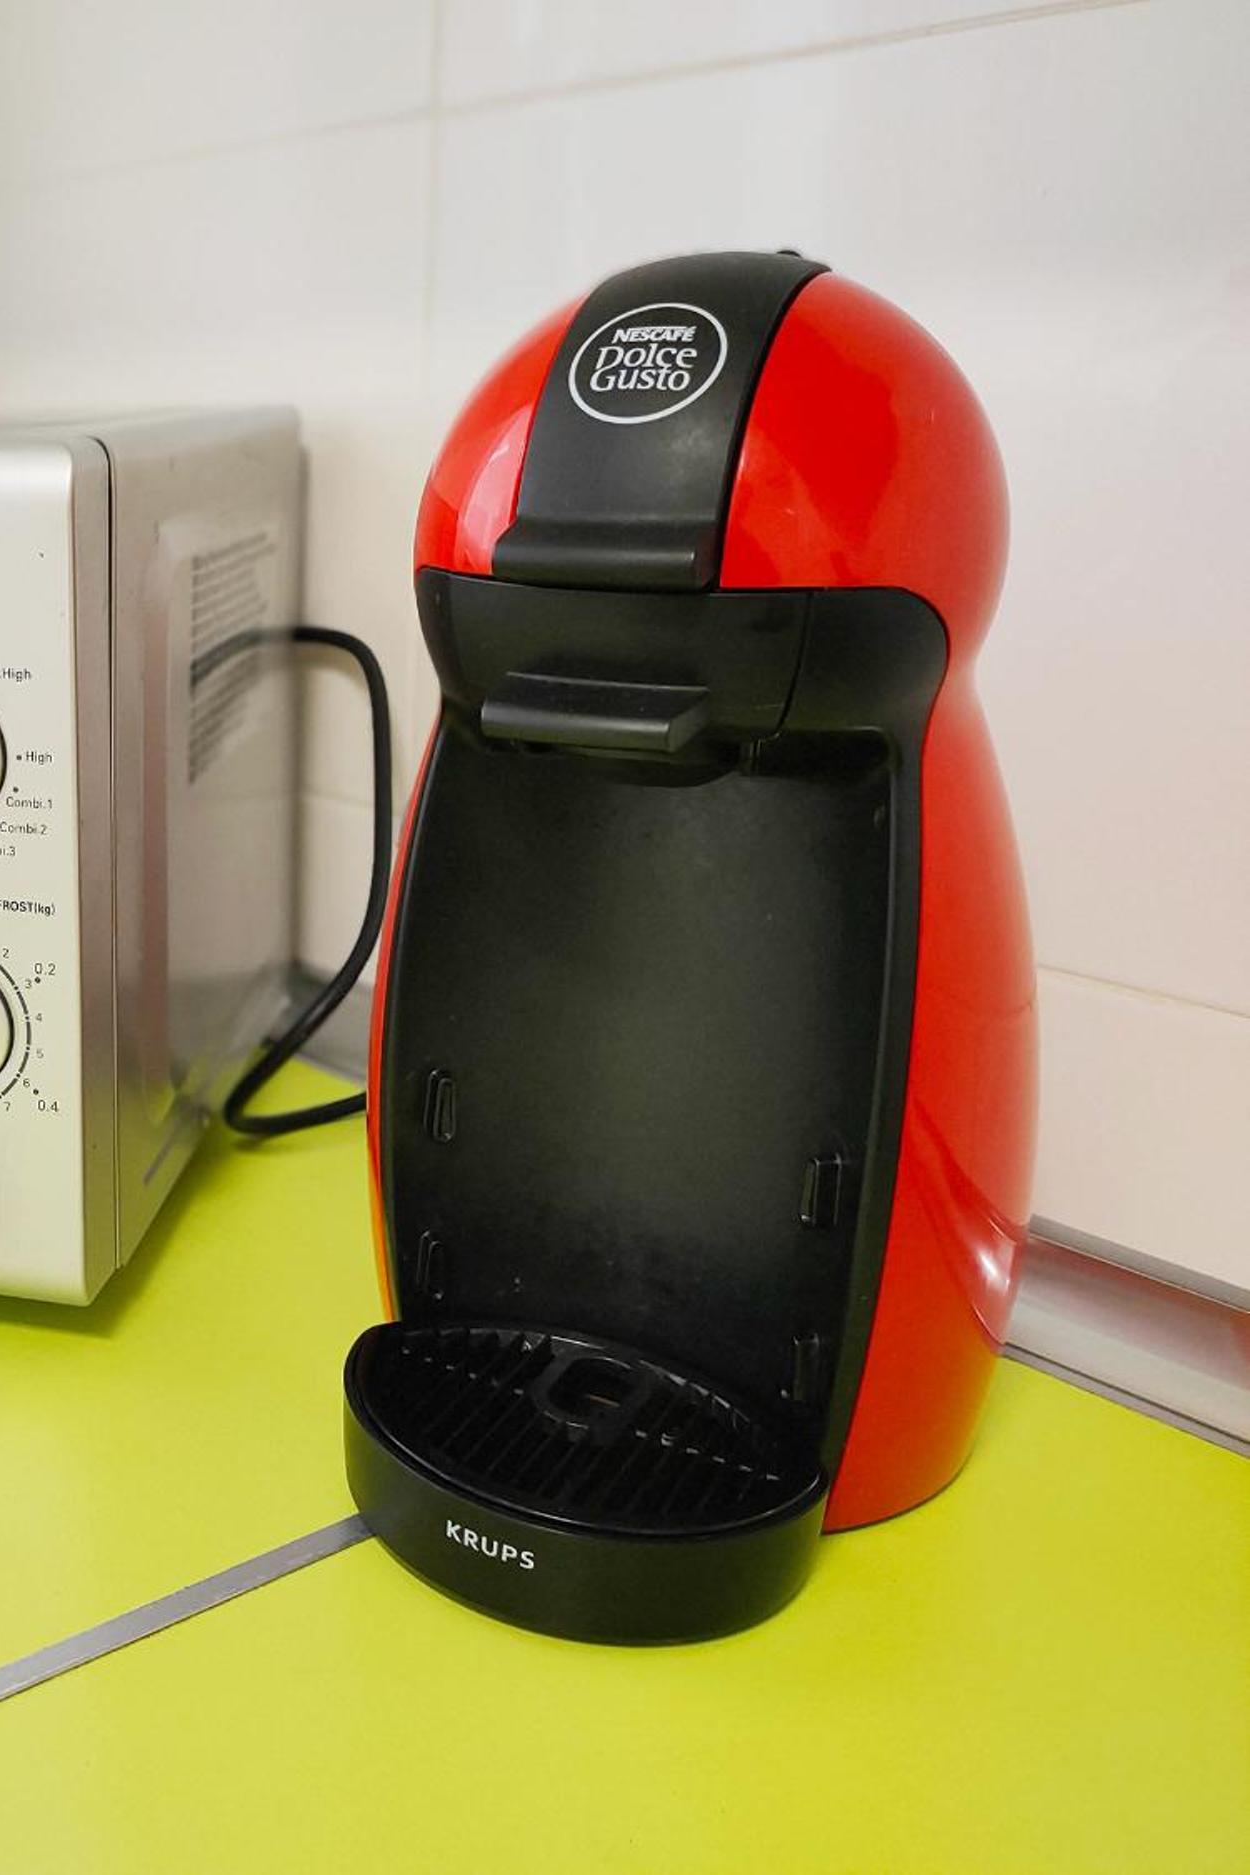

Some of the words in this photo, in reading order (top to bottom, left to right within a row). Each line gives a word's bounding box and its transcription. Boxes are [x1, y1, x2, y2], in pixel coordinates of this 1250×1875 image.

[611, 325, 697, 344] NESCAFÉ
[595, 343, 698, 370] Dolce
[589, 367, 691, 392] Gusto
[25, 752, 52, 765] High
[5, 797, 52, 810] Combi.1
[0, 822, 48, 835] Combi.2
[2, 948, 9, 958] 2
[34, 963, 56, 976] 0.2
[25, 979, 32, 990] 3
[35, 1013, 42, 1022] 4
[37, 1049, 44, 1059] 5
[22, 1078, 30, 1088] 6
[4, 1102, 11, 1111] 7
[37, 1101, 58, 1112] 0.4
[446, 1519, 534, 1569] KRUPS
